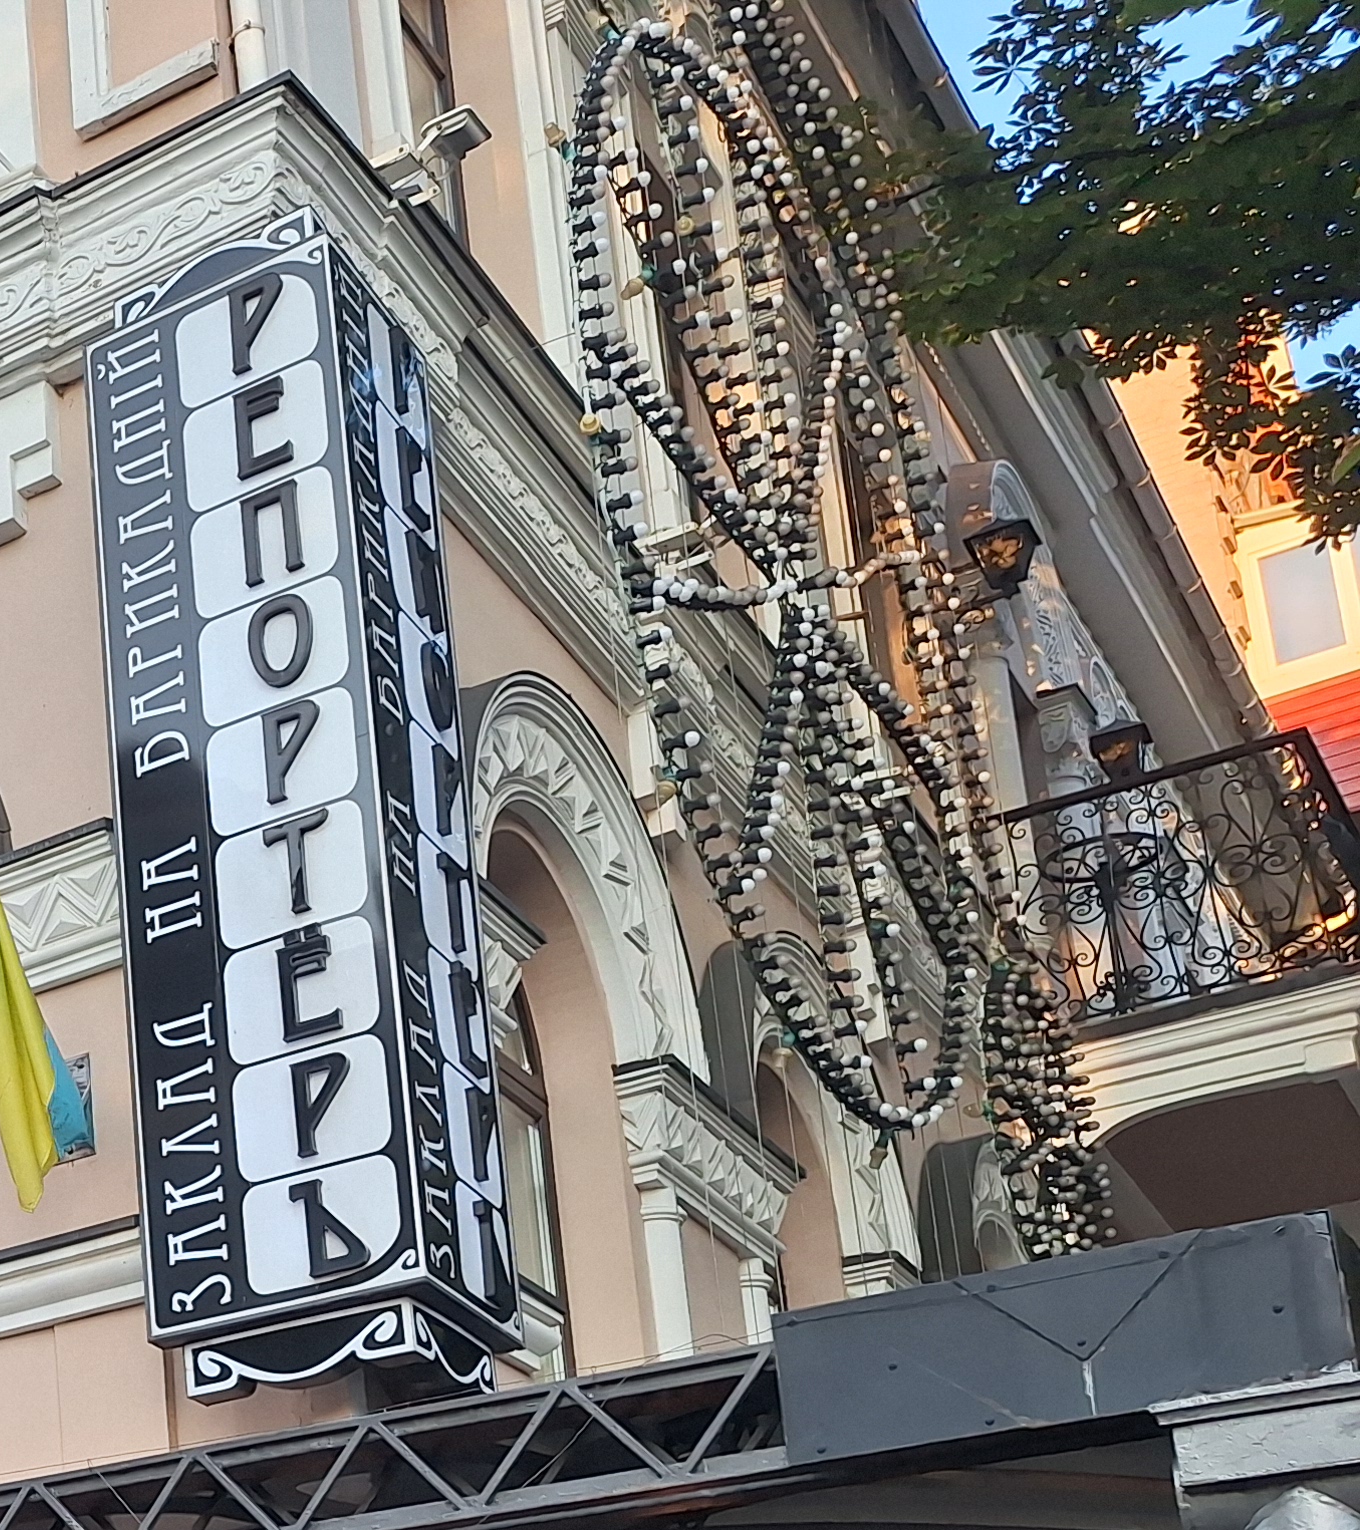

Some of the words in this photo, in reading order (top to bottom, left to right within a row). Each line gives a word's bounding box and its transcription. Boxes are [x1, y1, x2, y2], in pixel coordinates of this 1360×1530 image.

[96, 328, 191, 779] БАРИКАДНІЙ
[334, 263, 405, 726] БАРИКАДНІЙ
[141, 836, 203, 944] НА
[227, 272, 372, 1280] РЕПОРТЁРЪ
[386, 790, 417, 896] НА
[153, 1001, 233, 1313] ЗАКЛАД
[401, 960, 456, 1280] ЗАКЛАД
